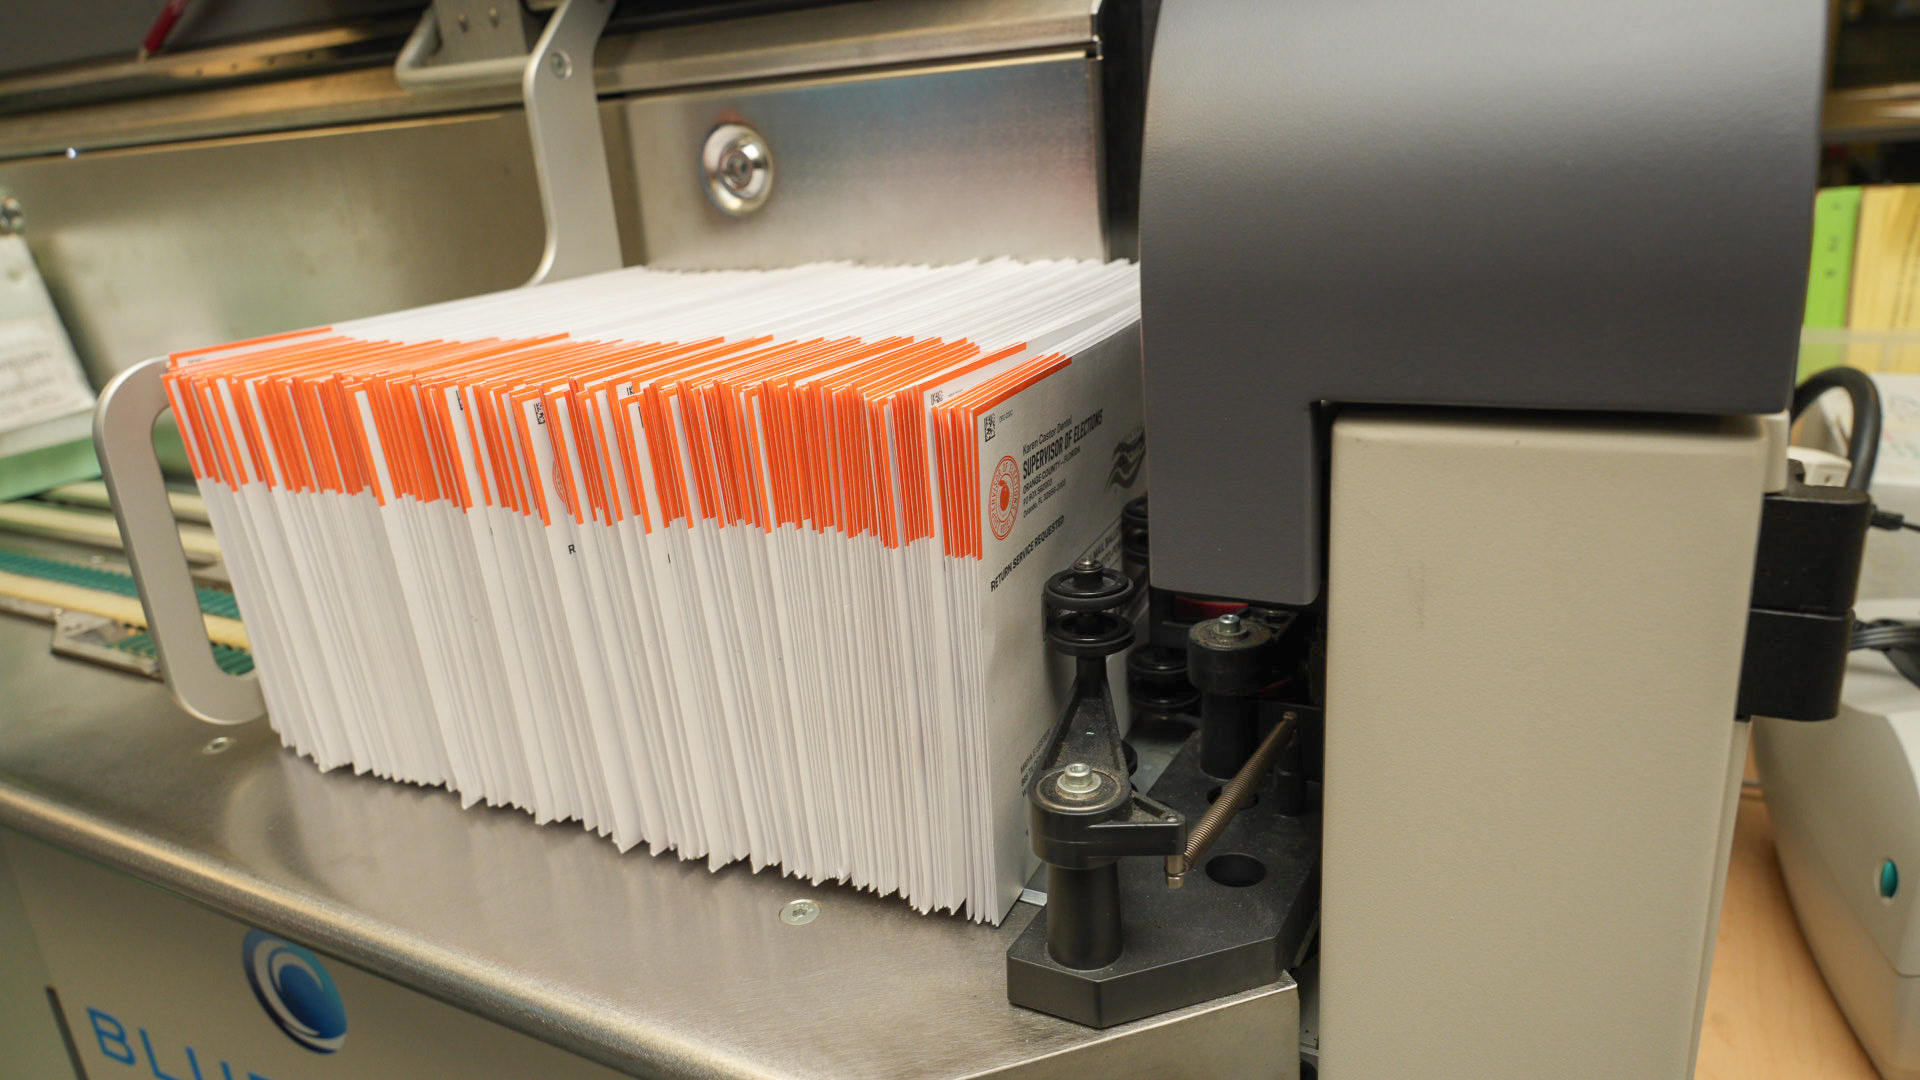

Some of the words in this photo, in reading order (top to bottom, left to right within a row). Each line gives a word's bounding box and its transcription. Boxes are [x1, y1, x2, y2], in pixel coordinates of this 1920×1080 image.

[1022, 439, 1038, 456] Karen
[1039, 428, 1056, 445] Castor
[1022, 436, 1064, 480] SUPERVISOR
[1064, 429, 1073, 450] OF
[1073, 408, 1104, 444] ELECTIONS
[1022, 473, 1042, 495] ORANGE
[1041, 460, 1061, 480] COUNTY
[990, 562, 1013, 593] RETURN
[1012, 540, 1034, 569] SERVICE
[1034, 514, 1065, 548] REQUESTED
[87, 1006, 275, 1080] BLU
